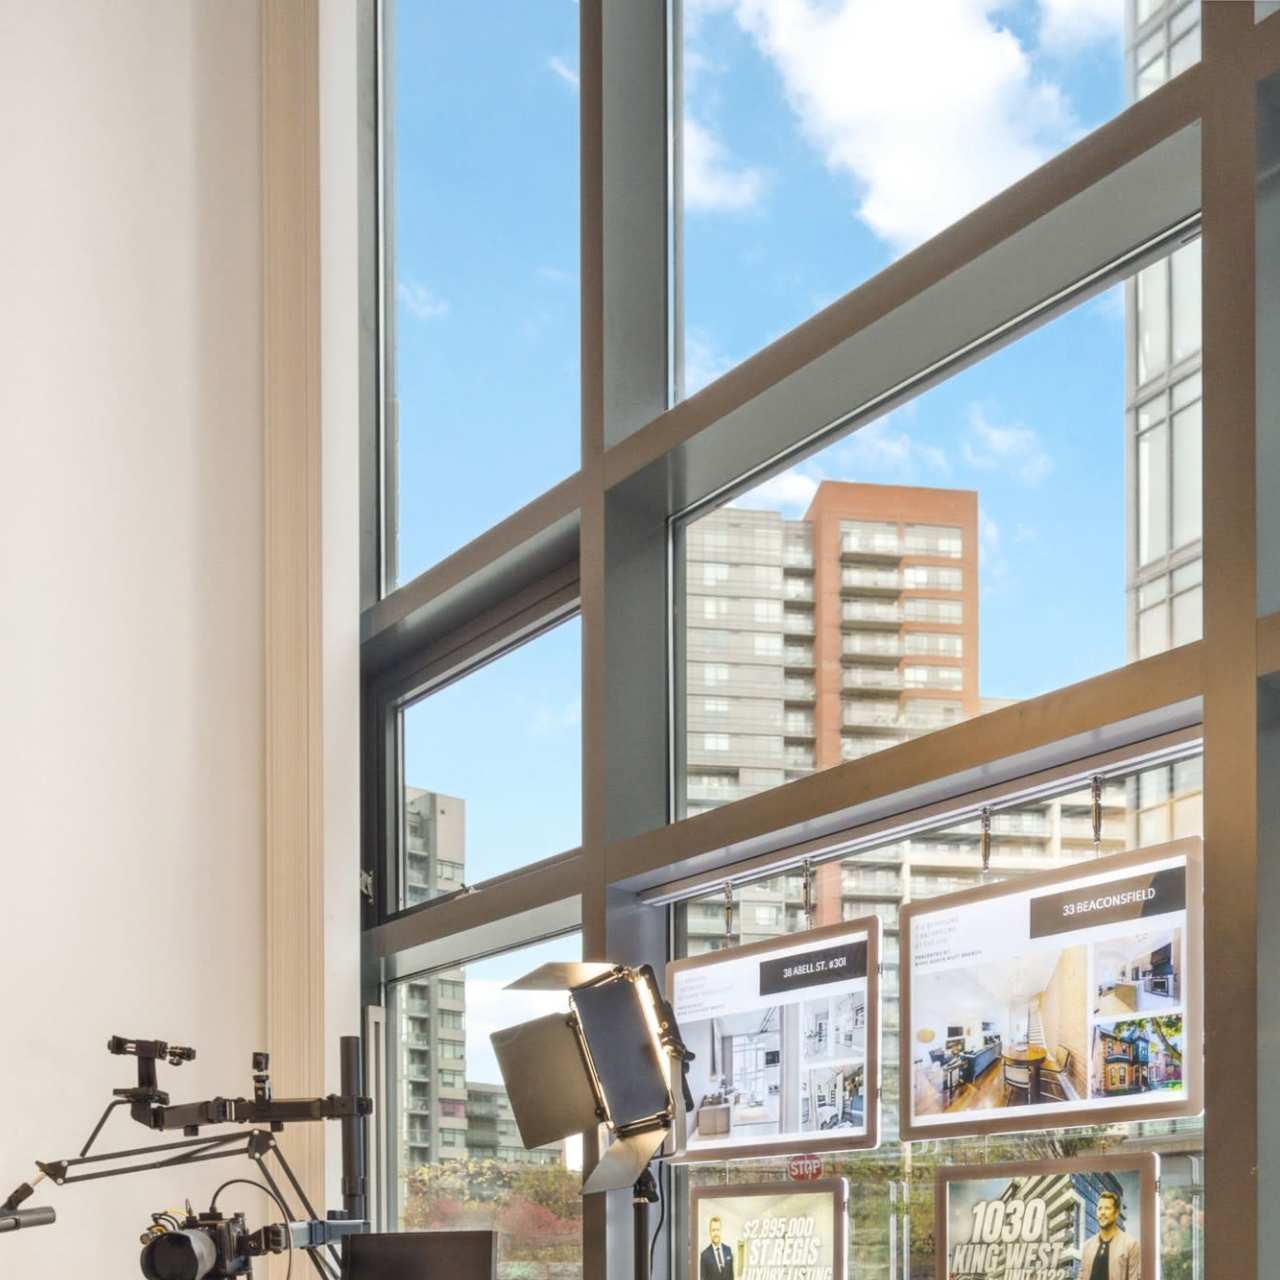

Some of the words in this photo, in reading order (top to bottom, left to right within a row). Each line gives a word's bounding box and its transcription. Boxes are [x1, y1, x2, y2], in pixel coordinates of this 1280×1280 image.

[1063, 903, 1075, 916] 33
[1076, 887, 1156, 914] BEACONSFIELD
[793, 962, 814, 976] ABELL
[815, 960, 828, 972] ST.
[791, 1160, 821, 1176] STOP
[972, 1198, 1046, 1243] 1030
[773, 1237, 820, 1266] REGIS
[952, 1243, 1001, 1274] KING
[1005, 1242, 1065, 1270] WEST
